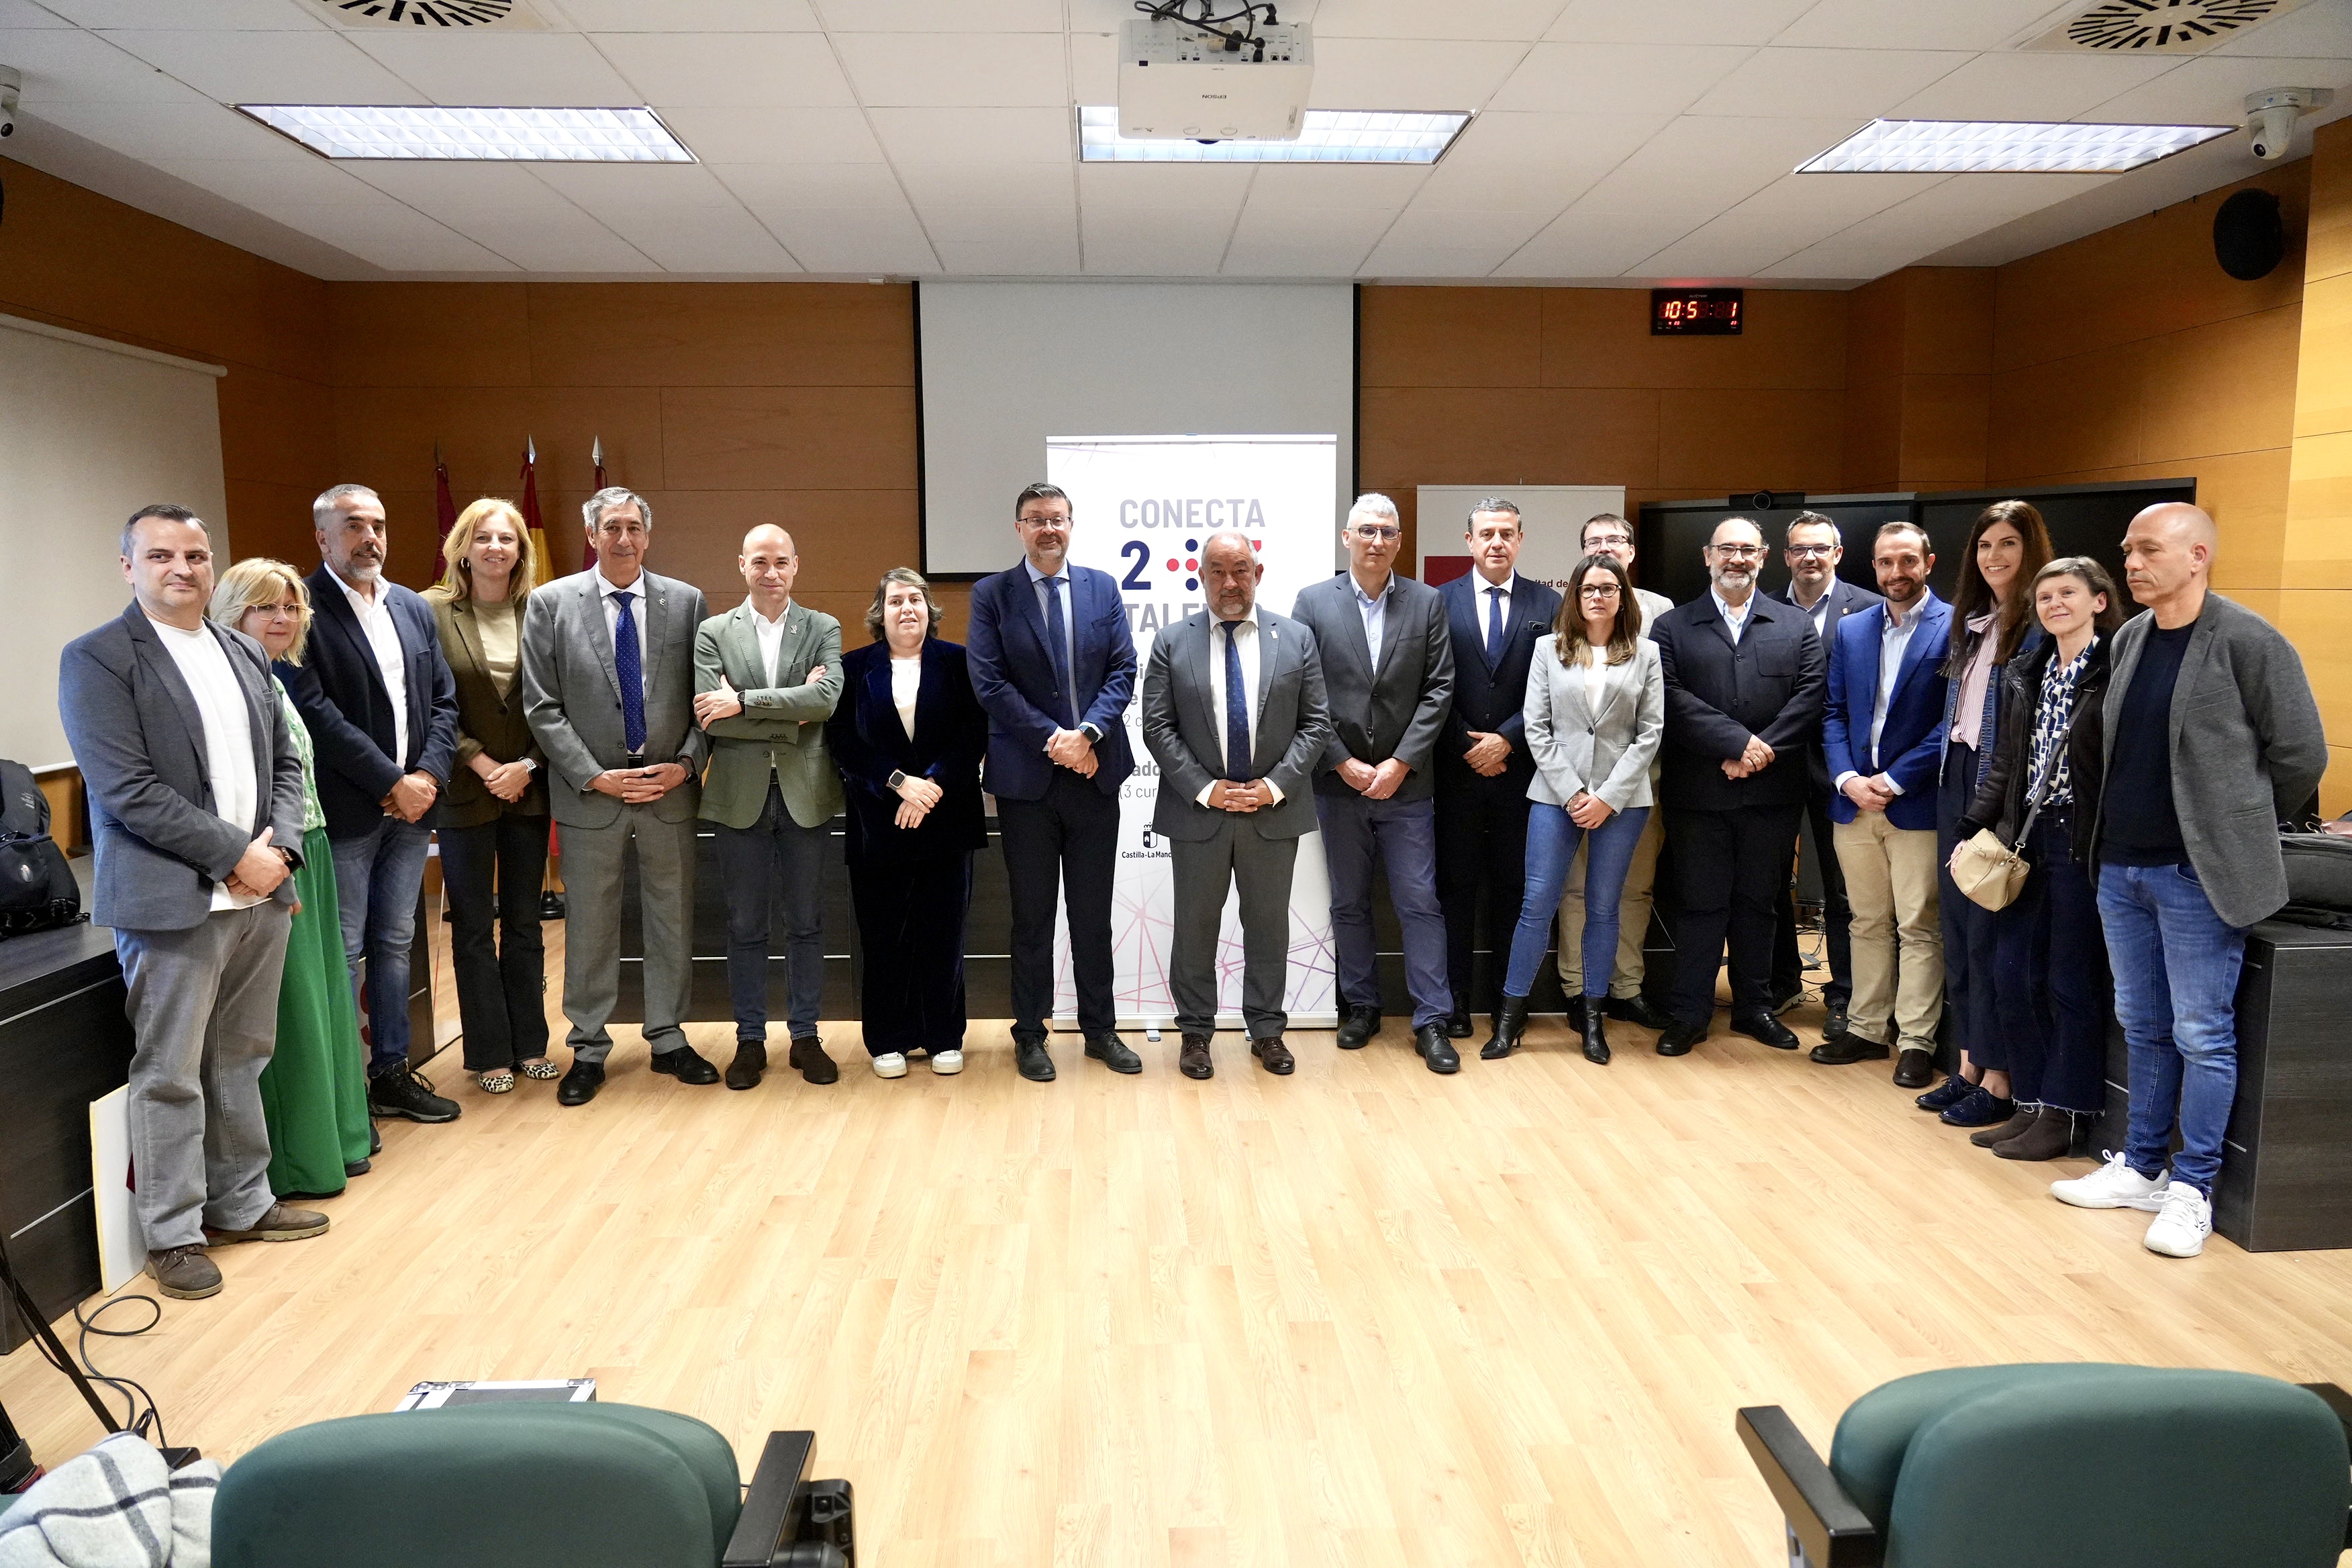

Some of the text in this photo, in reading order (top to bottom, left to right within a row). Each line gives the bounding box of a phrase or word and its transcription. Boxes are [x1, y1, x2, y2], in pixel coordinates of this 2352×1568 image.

[1120, 499, 1266, 528] CONECTA
[1121, 540, 1151, 590] 2
[1556, 579, 1569, 588] de
[1136, 787, 1157, 798] cur
